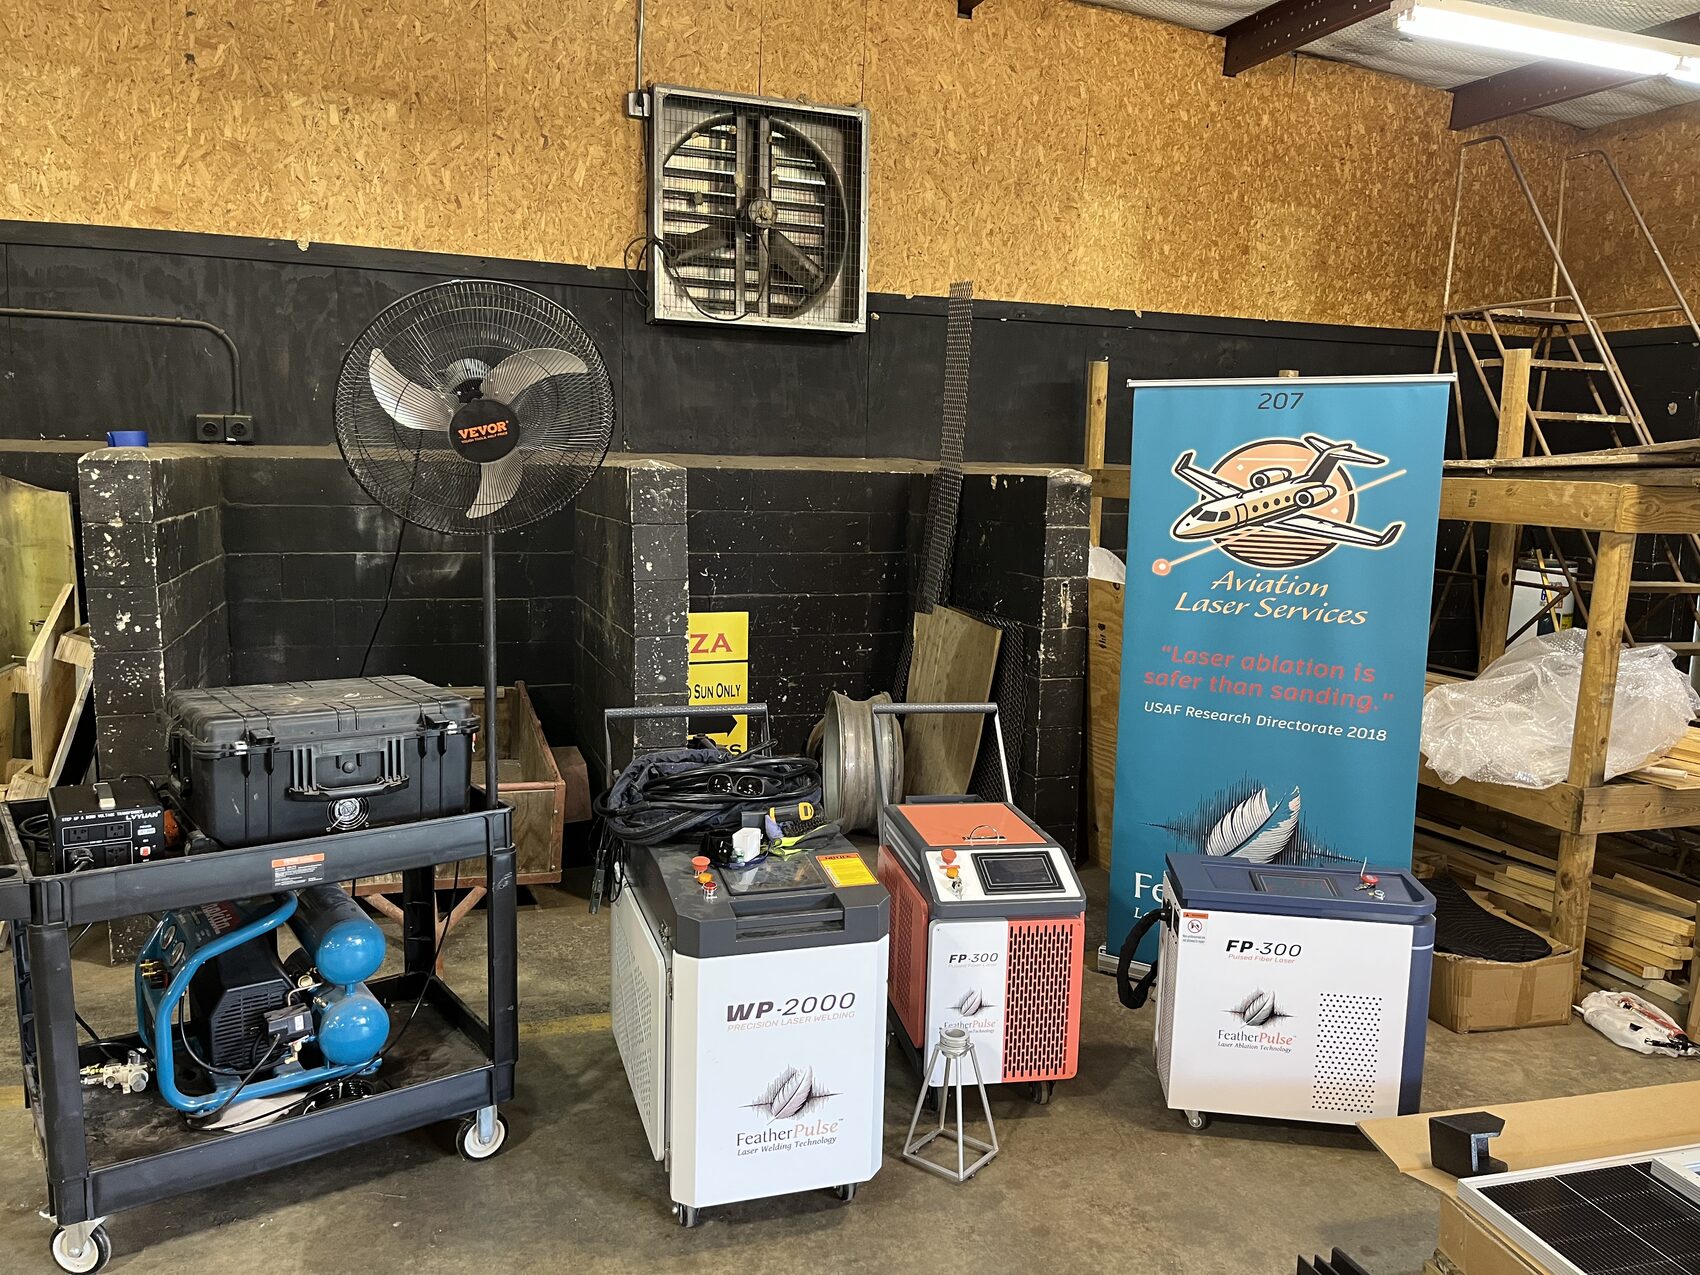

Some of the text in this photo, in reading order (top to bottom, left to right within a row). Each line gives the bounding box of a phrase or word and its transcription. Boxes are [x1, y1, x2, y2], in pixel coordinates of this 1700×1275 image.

[1257, 392, 1304, 410] 207
[458, 421, 507, 439] VEVOR
[1210, 570, 1329, 598] Aviation
[1174, 591, 1369, 625] Laser Services
[1241, 653, 1345, 681] ablation
[1354, 662, 1376, 683] is
[694, 684, 714, 699] SUN
[715, 683, 741, 698] ONLY
[1143, 670, 1203, 690] safer
[1209, 675, 1263, 697] than
[1144, 701, 1388, 742] USAF Research Directorate 2018
[949, 952, 999, 963] FP-300
[1225, 939, 1302, 957] FP-300
[1228, 953, 1253, 961] Pulsed
[727, 992, 856, 1022] WP-2000
[727, 1011, 856, 1032] PRECISION LASER WELDING
[1218, 1029, 1293, 1045] FeatherPulse
[1259, 1045, 1292, 1053] Technology
[737, 1119, 839, 1147] FeatherPulse
[737, 1136, 837, 1156] Laser Welding Technology
